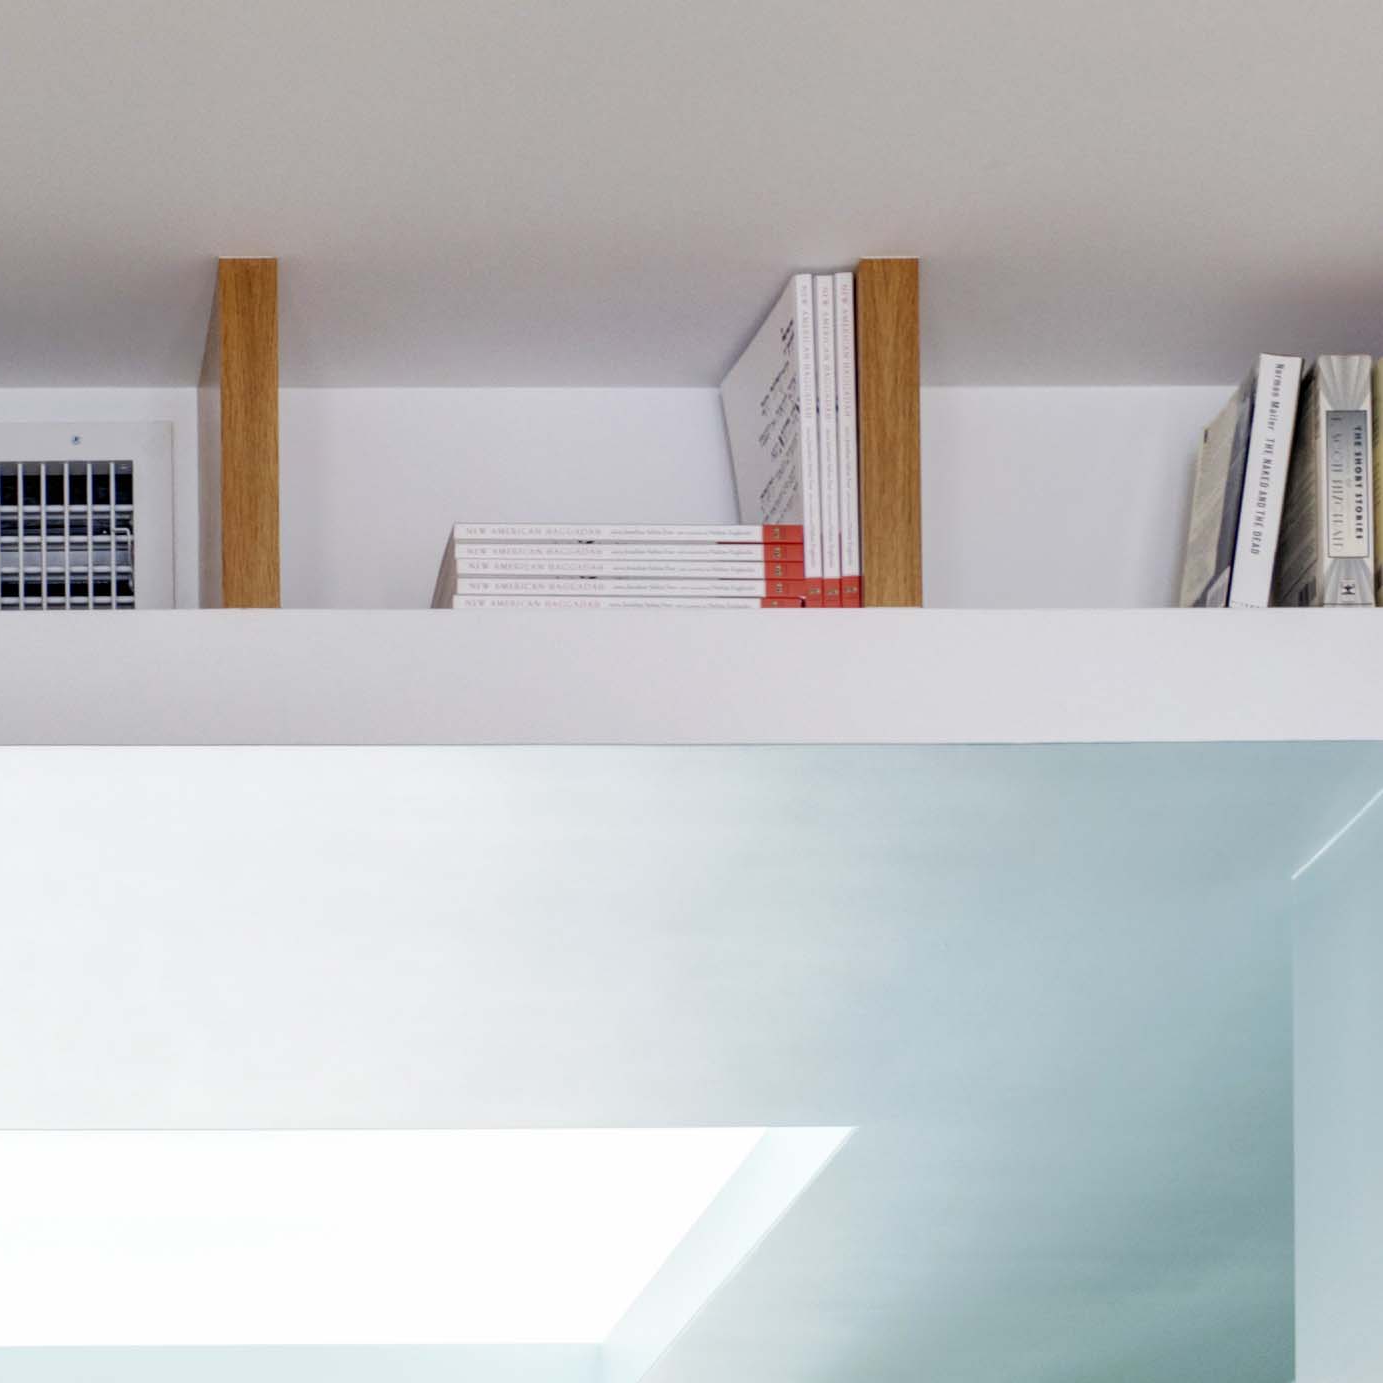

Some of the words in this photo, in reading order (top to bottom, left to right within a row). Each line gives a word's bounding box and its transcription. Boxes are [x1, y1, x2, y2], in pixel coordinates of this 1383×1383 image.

[1264, 439, 1275, 455] THE
[1259, 458, 1272, 487] NAKED
[1257, 491, 1269, 507] AND
[1253, 511, 1266, 527] THE
[1250, 531, 1262, 555] DEAD
